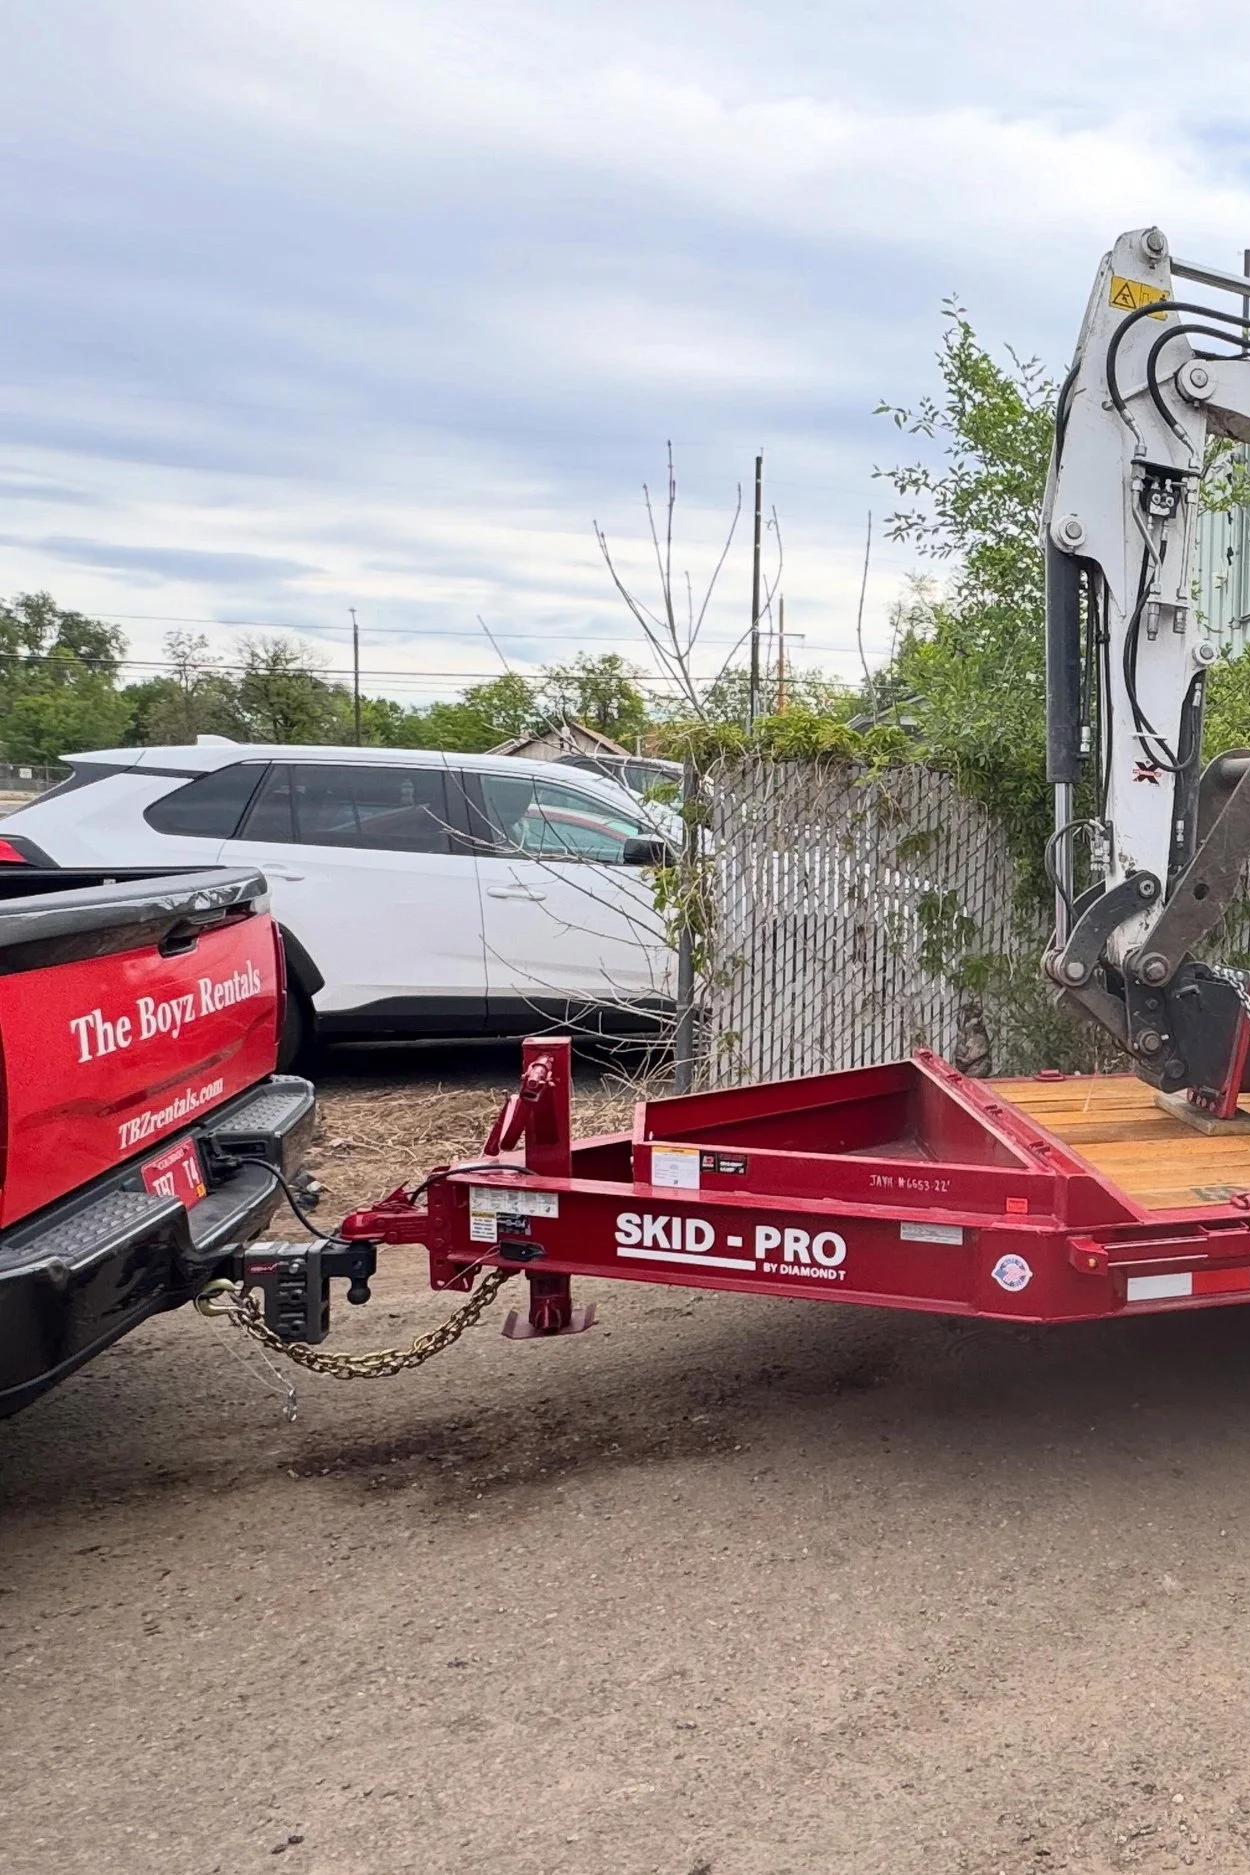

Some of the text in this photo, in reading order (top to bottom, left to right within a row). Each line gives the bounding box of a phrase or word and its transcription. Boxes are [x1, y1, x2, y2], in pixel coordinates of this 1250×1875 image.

[70, 960, 262, 1064] The Boyz Rentals
[118, 1077, 224, 1150] TBZrentals.com
[614, 1211, 716, 1252] SKID
[755, 1225, 847, 1267] PRO
[763, 1261, 847, 1281] BY DIAMOND T
